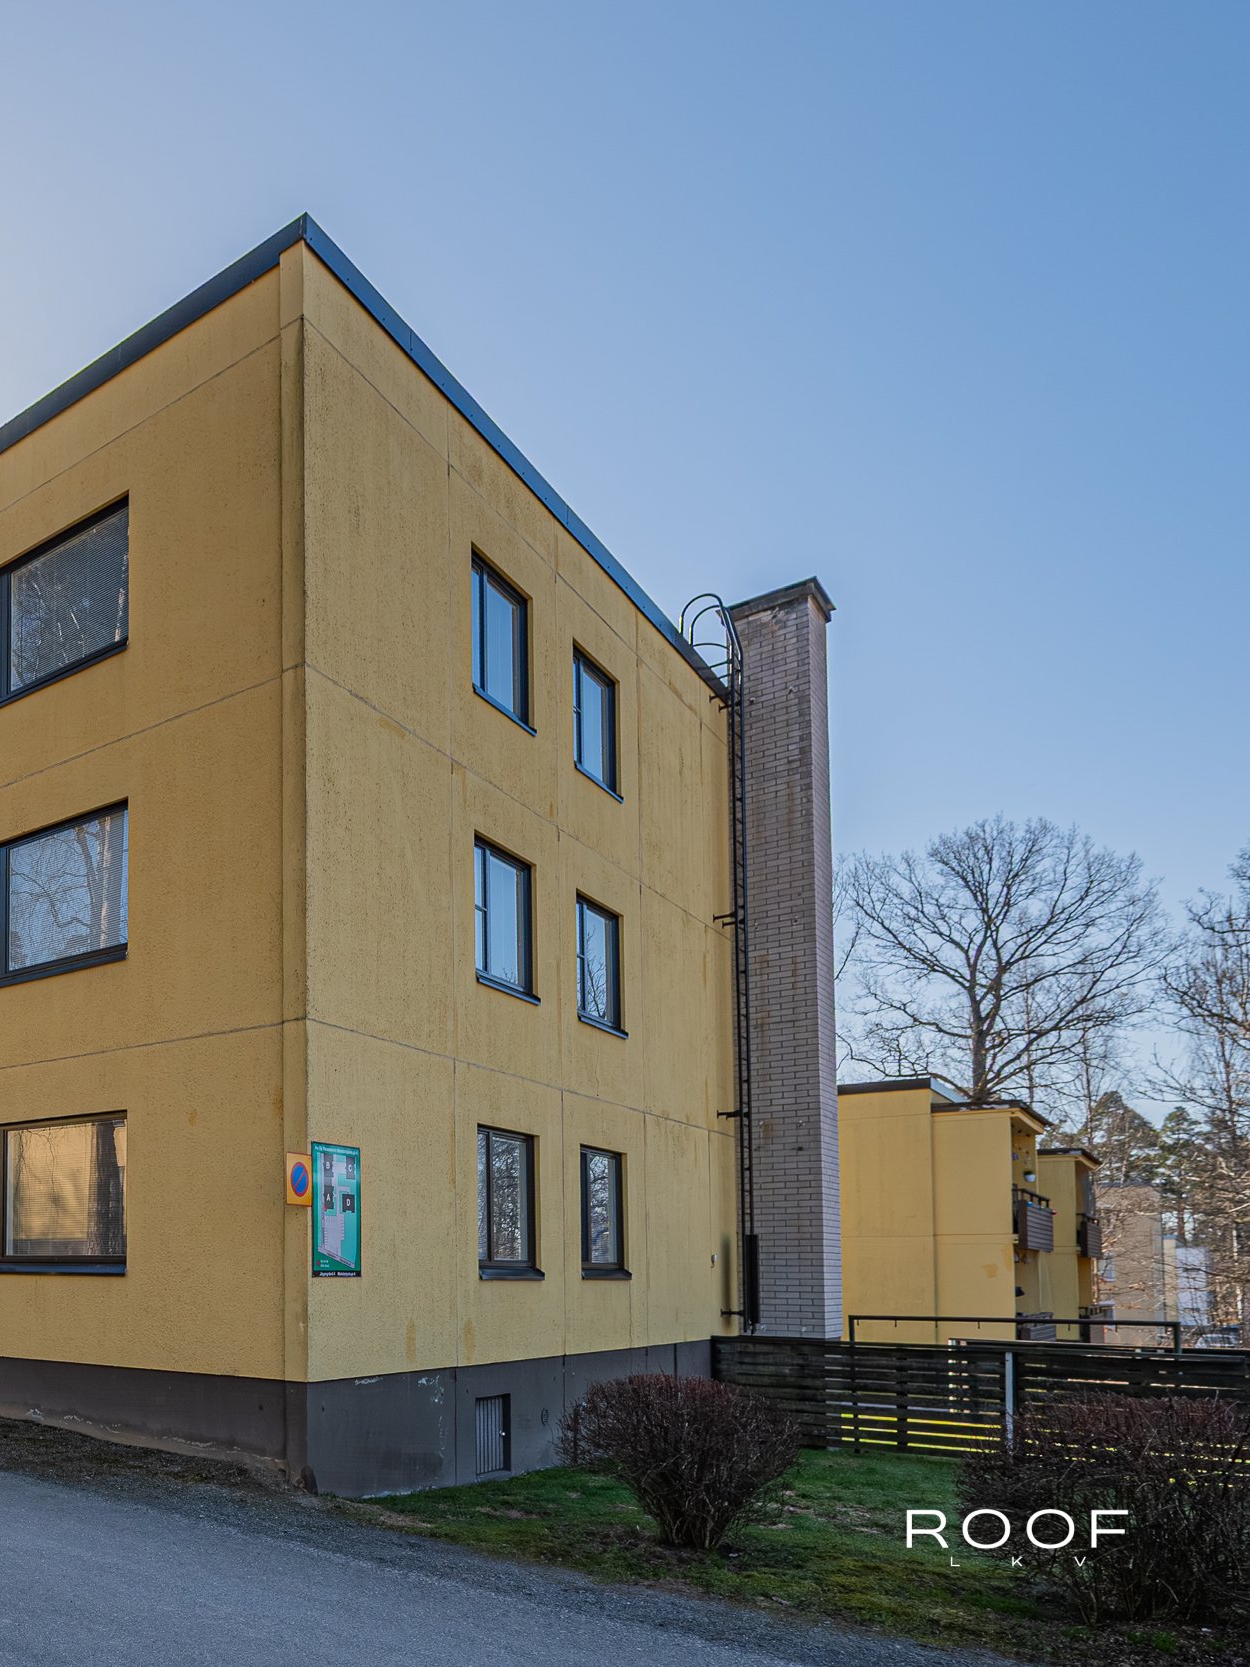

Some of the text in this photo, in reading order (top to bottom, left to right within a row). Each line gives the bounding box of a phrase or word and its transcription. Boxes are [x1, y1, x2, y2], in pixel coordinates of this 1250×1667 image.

[325, 1161, 331, 1170] B
[348, 1164, 353, 1172] C
[326, 1193, 331, 1202] A
[346, 1198, 351, 1207] D
